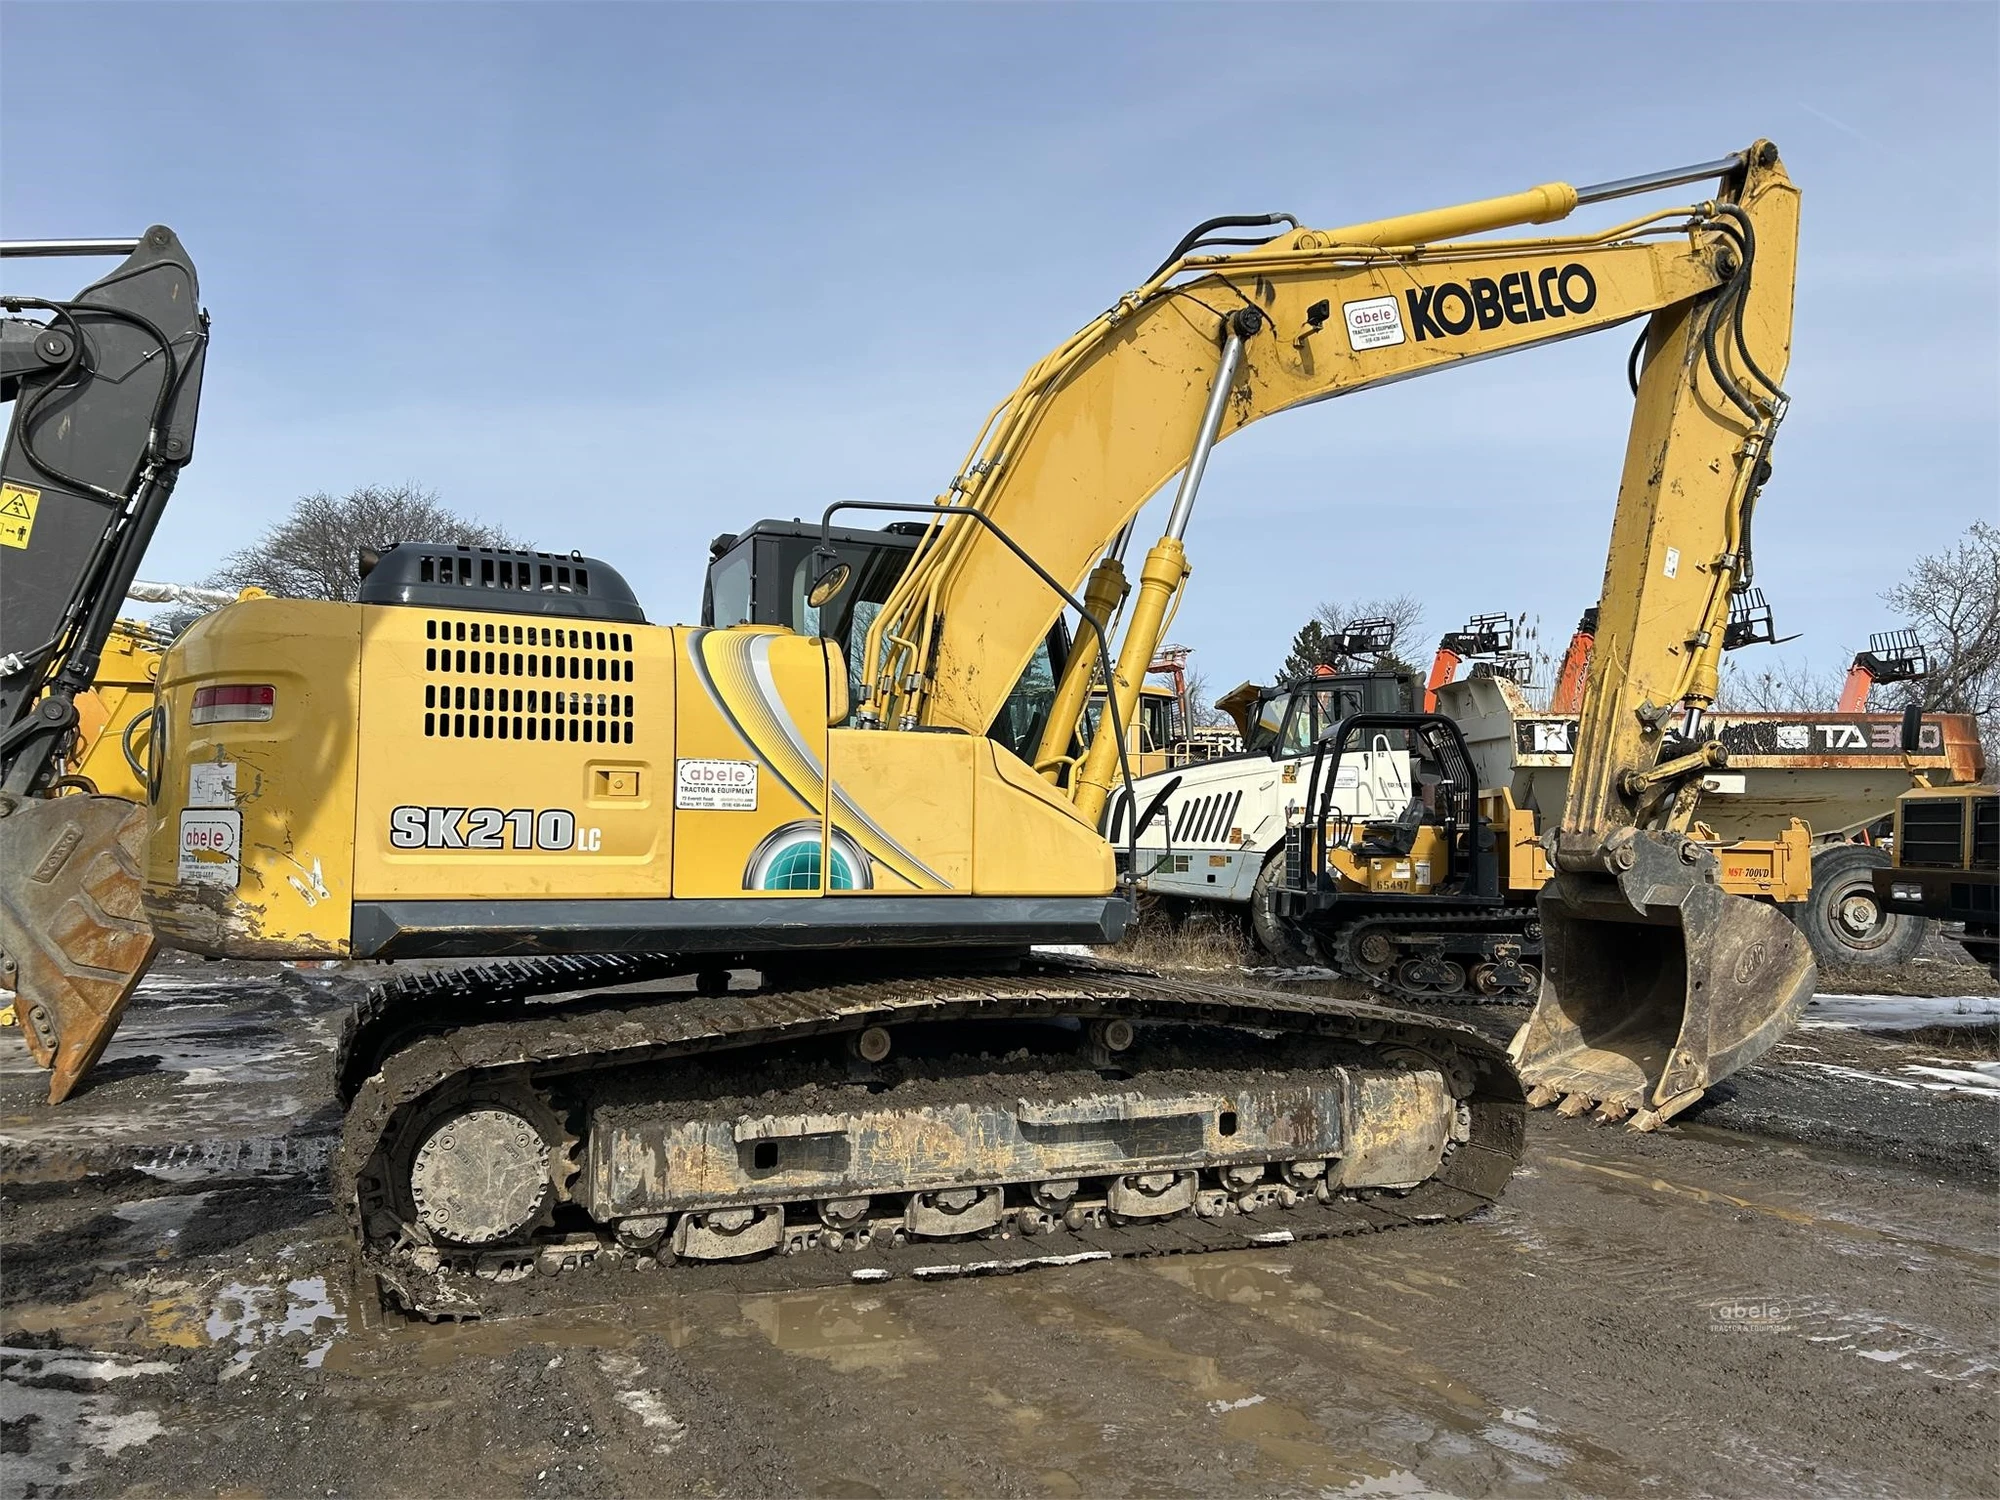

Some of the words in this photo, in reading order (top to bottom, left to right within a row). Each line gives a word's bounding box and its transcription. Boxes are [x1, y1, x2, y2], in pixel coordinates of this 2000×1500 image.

[1405, 263, 1597, 342] KOBELCO
[1355, 309, 1391, 325] abele
[1352, 328, 1371, 336] TRACTOR
[1375, 323, 1399, 332] EQUIPMENT
[1815, 725, 1940, 749] TA30
[690, 766, 745, 782] abele
[186, 827, 224, 847] abele
[390, 805, 576, 851] SK210
[577, 827, 601, 852] LC
